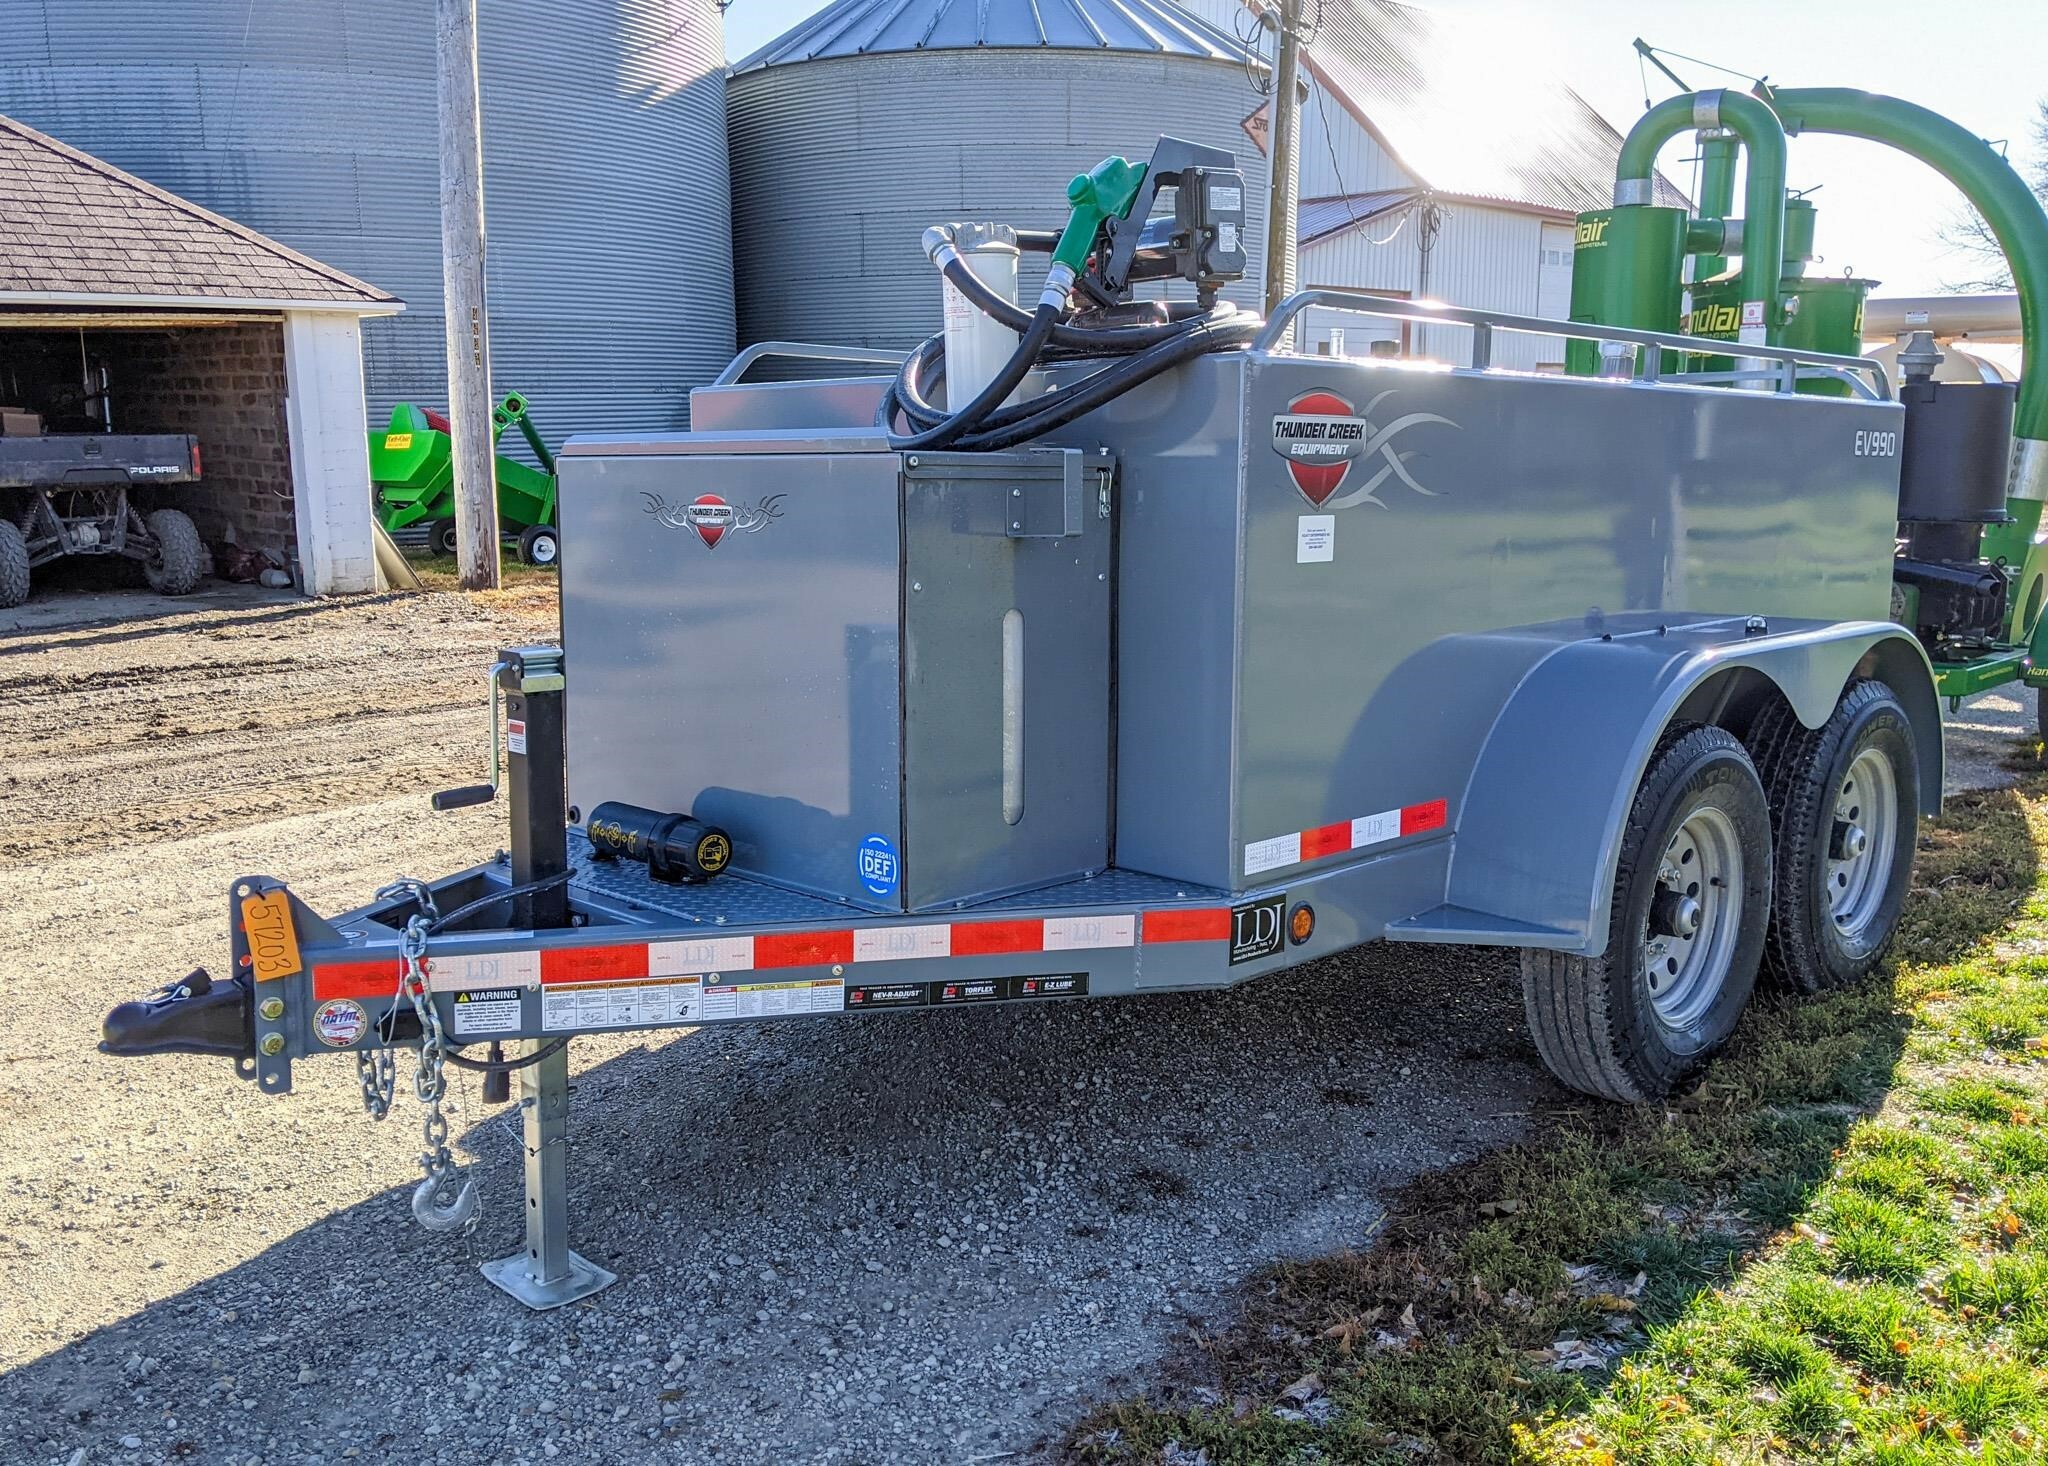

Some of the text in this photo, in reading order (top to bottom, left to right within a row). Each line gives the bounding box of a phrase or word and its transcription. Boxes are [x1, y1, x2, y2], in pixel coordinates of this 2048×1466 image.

[1275, 421, 1364, 440] THUNDER CREEK
[1290, 443, 1349, 456] EQUIPMENT
[1855, 430, 1896, 457] EV990
[130, 466, 180, 474] POLARIS
[690, 507, 731, 517] THUNDER CREEK
[865, 848, 892, 861] ISO 22241
[865, 855, 892, 876] DEF
[865, 872, 892, 884] COMPLIANT
[1233, 903, 1285, 951] LDJ
[250, 904, 292, 972] 57203
[470, 990, 518, 1001] WARNING
[872, 990, 919, 998] NEV-R-ADJUST
[964, 986, 994, 994] TORFLEX
